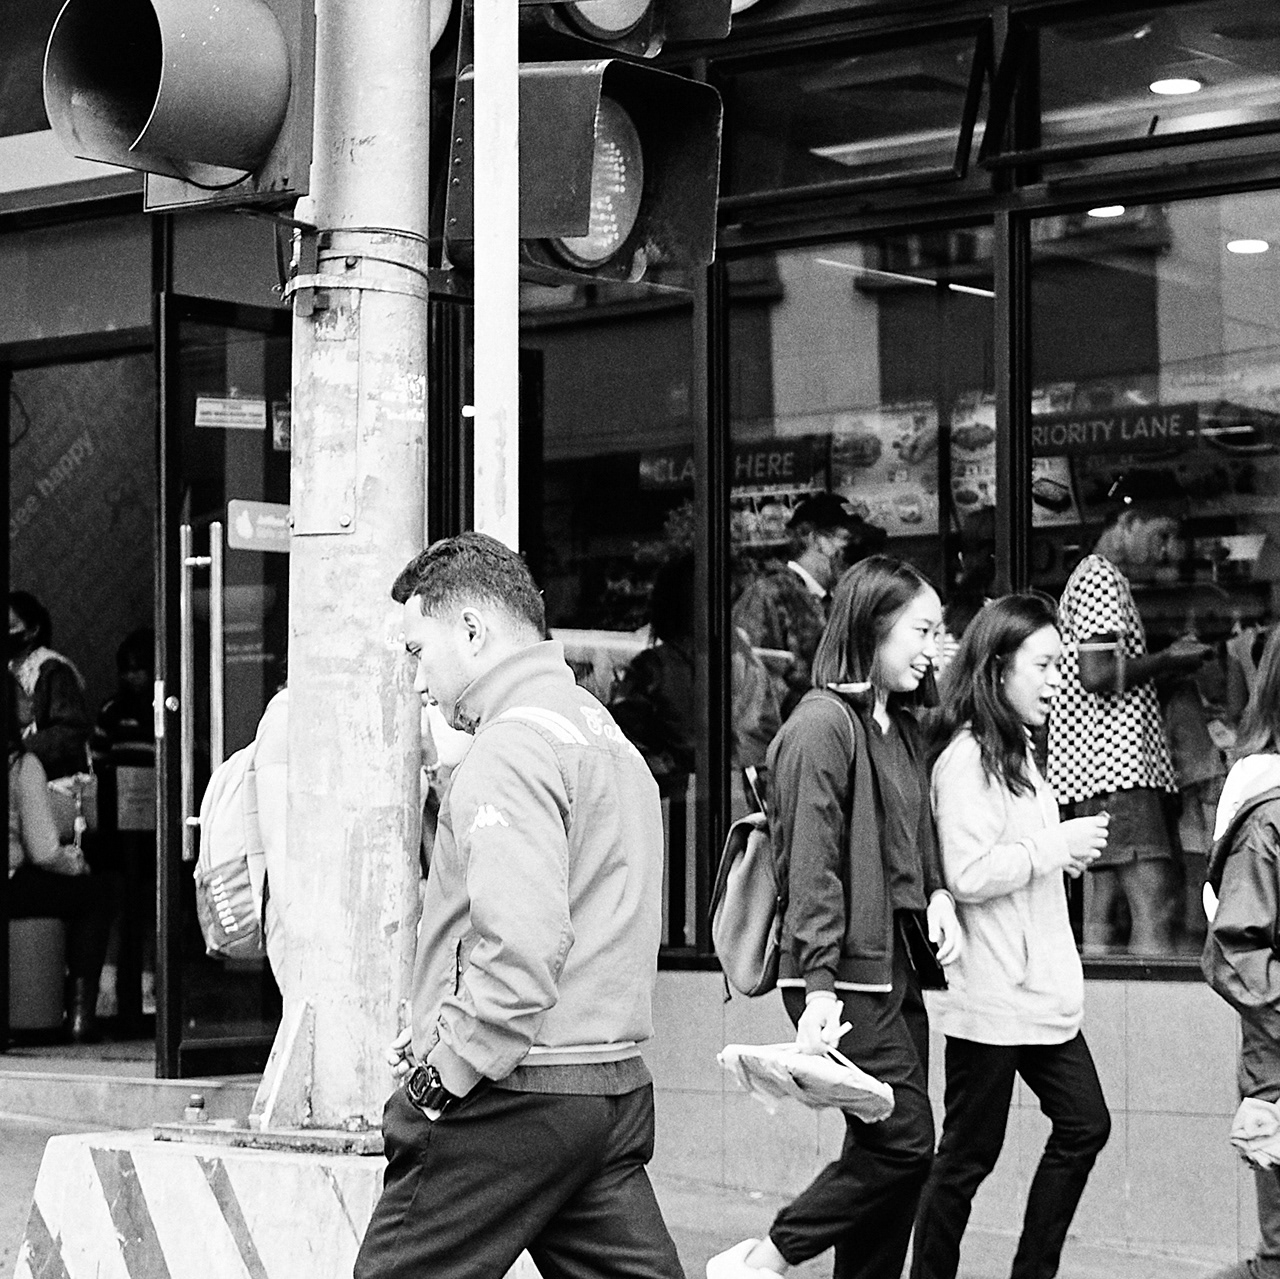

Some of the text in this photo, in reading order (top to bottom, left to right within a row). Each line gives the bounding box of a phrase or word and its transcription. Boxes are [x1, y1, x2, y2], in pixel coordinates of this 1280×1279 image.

[1031, 414, 1182, 446] RIORITY LANE
[734, 451, 795, 479] HERE
